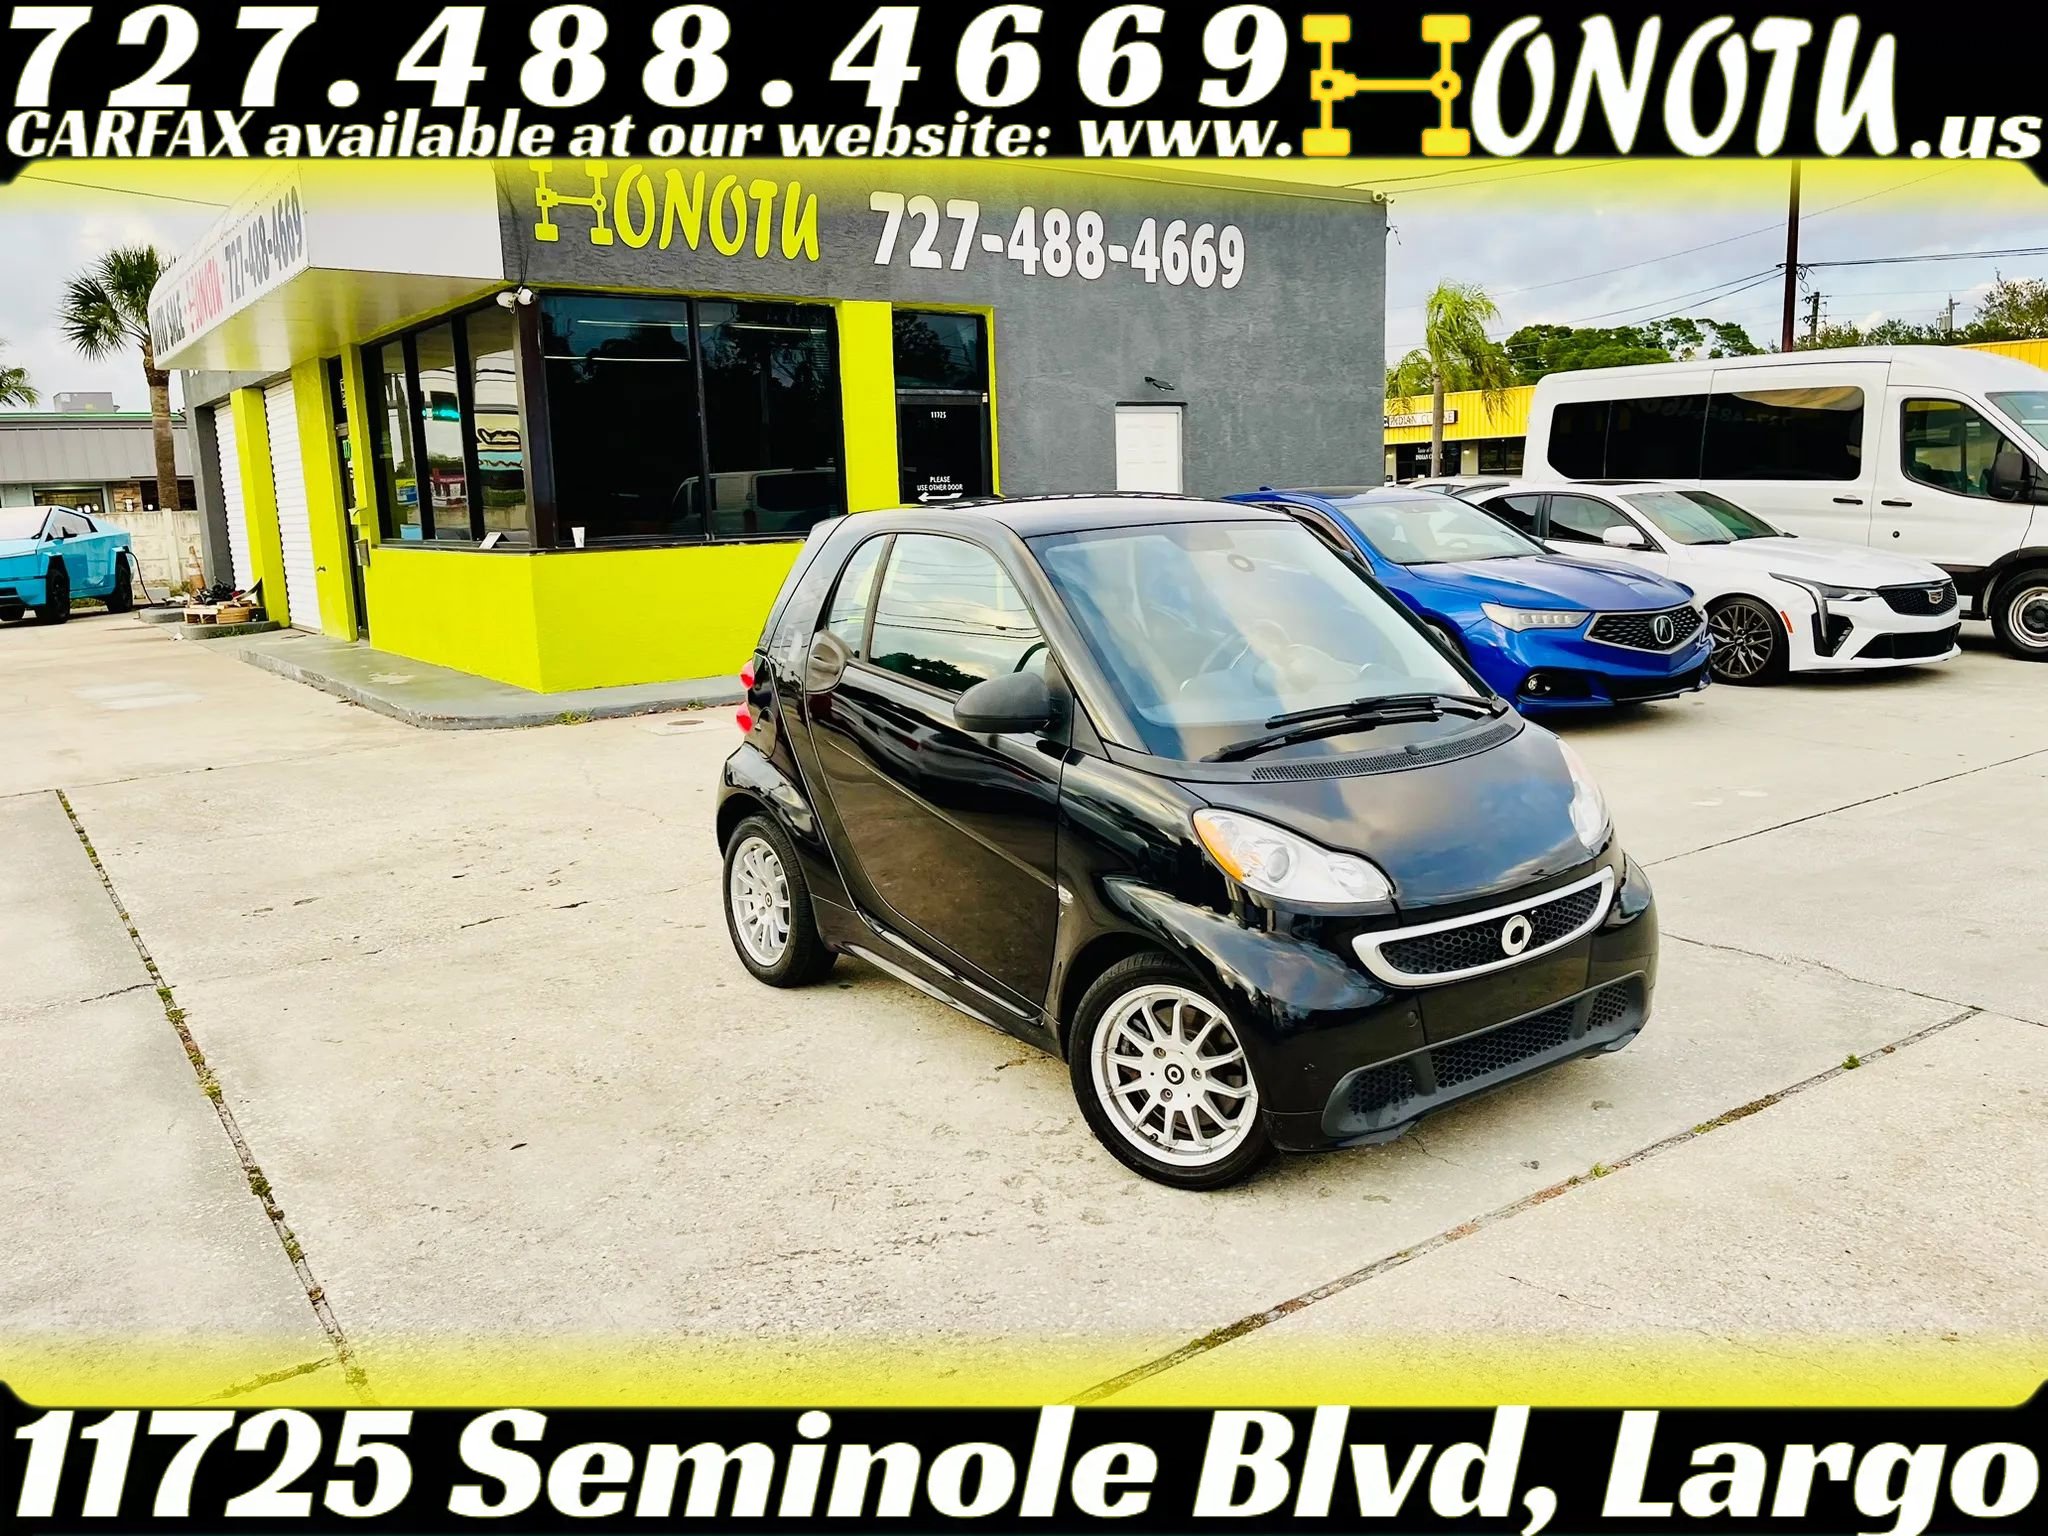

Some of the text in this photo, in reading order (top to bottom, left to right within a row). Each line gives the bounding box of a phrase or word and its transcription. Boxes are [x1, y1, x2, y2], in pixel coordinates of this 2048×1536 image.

[225, 186, 303, 303] 727-488-4669
[869, 190, 1246, 290] 727-488-4669
[930, 411, 947, 419] 11725
[1389, 414, 1418, 426] INDIAN
